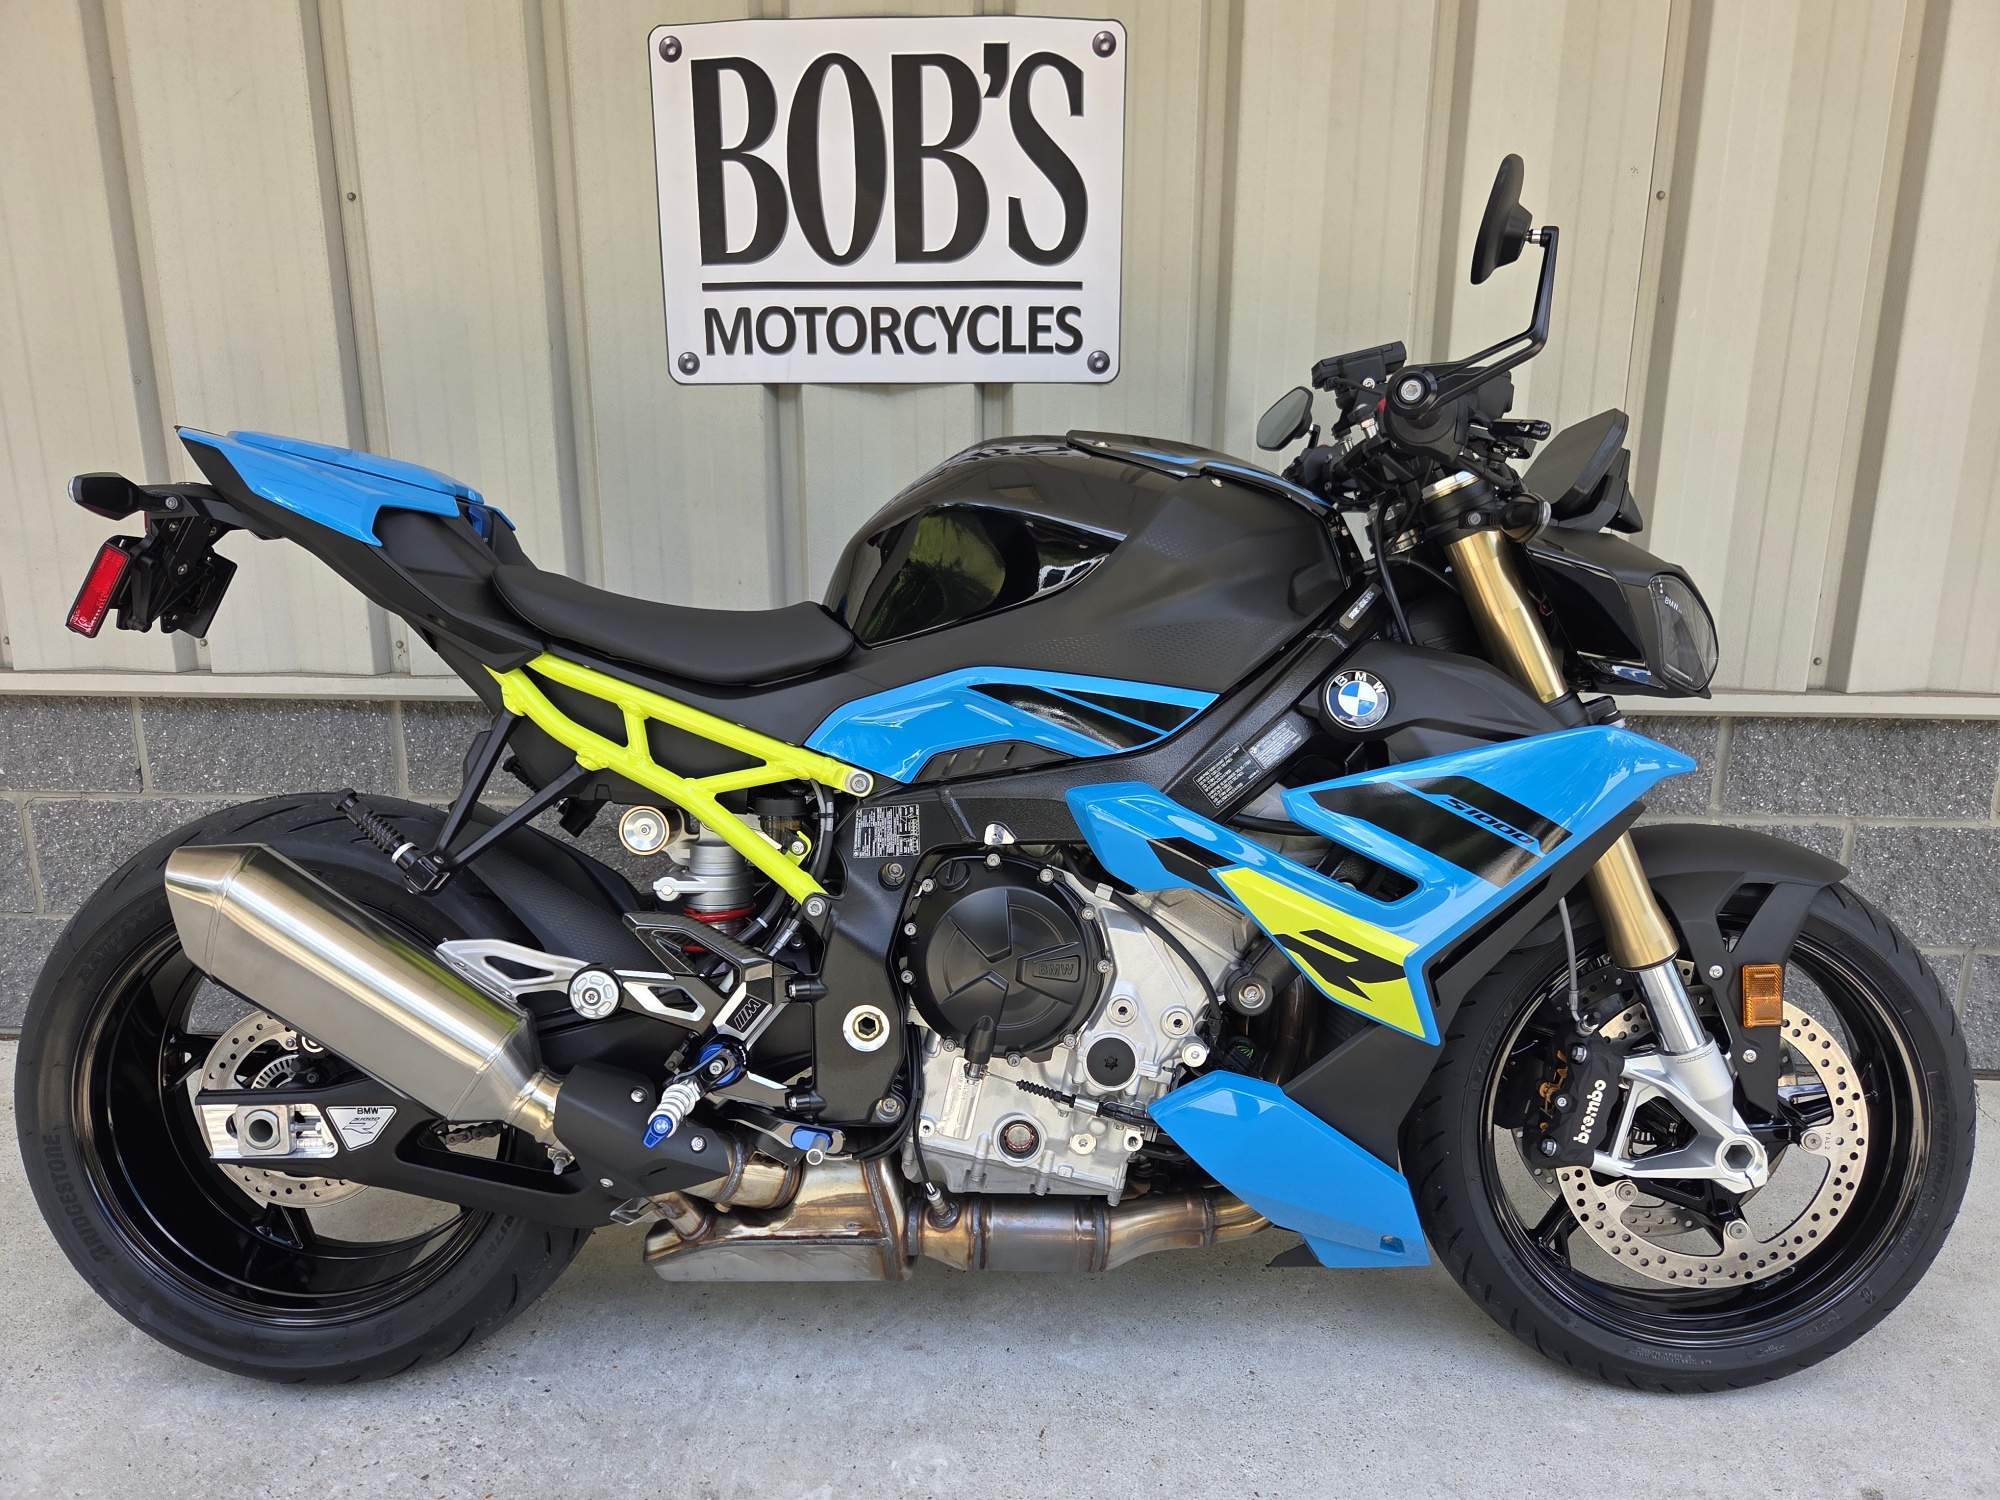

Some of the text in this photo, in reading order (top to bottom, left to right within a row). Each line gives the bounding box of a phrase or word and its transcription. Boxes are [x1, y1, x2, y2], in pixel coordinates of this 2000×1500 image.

[690, 41, 1089, 266] BOB'S
[705, 304, 1085, 356] MOTORCYCLES
[1664, 596, 1679, 611] BMW
[1441, 798, 1535, 844] S1000
[1039, 963, 1075, 976] BMW
[357, 1107, 379, 1115] BMW
[1573, 1079, 1607, 1144] brembo
[42, 1133, 115, 1263] BRIDGESTONE
